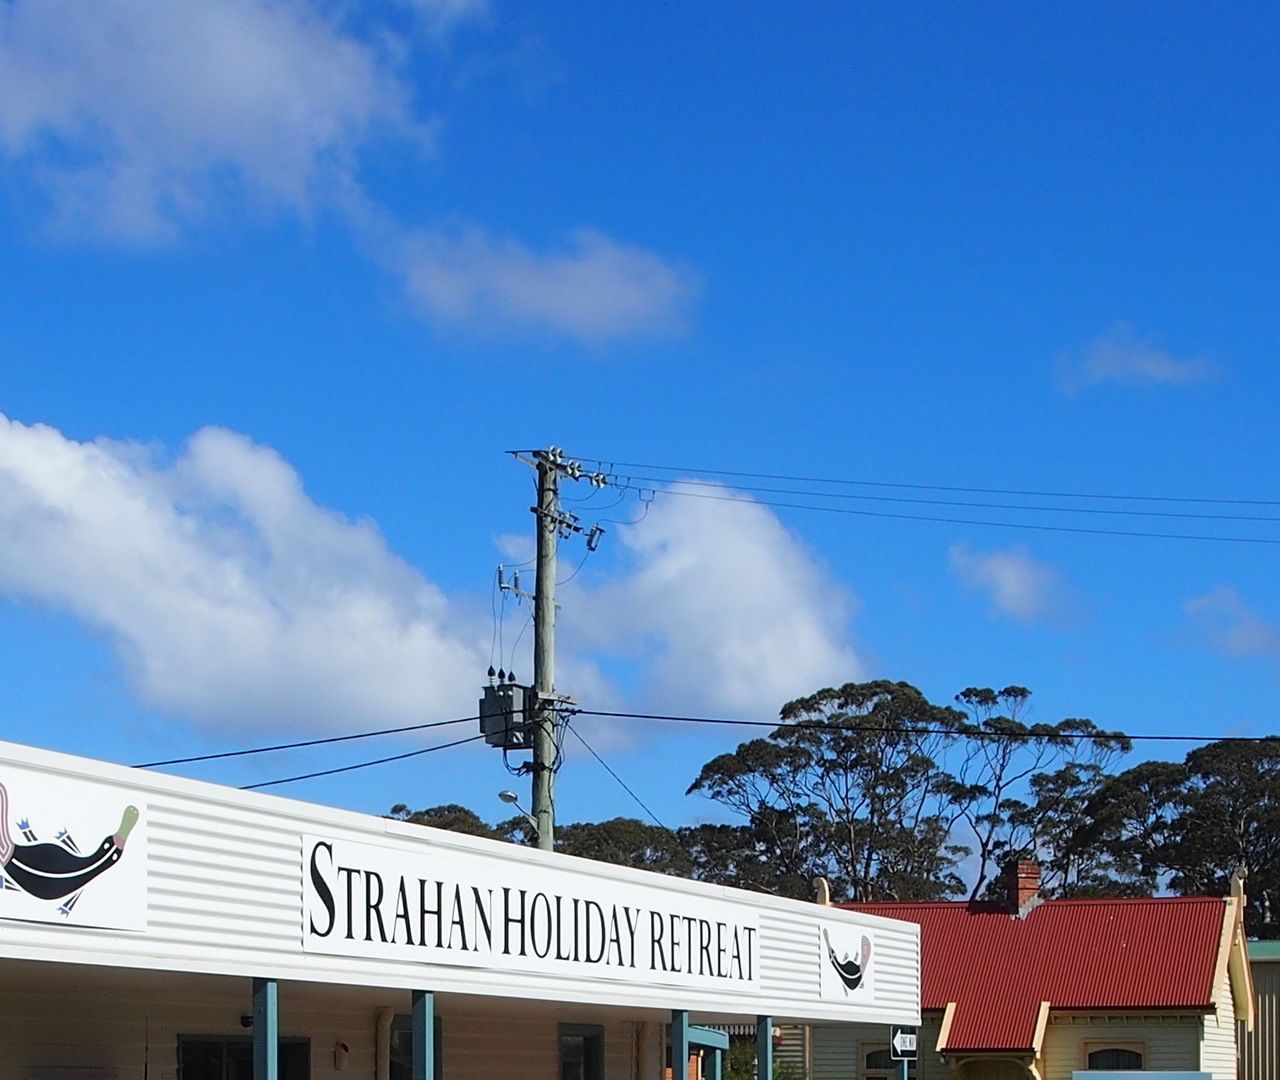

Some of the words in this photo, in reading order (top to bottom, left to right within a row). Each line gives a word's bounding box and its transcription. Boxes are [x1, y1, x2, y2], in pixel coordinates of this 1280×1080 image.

[310, 841, 493, 953] STRAHAN
[501, 887, 641, 968] HOLIDAY
[649, 911, 756, 981] RETREAT
